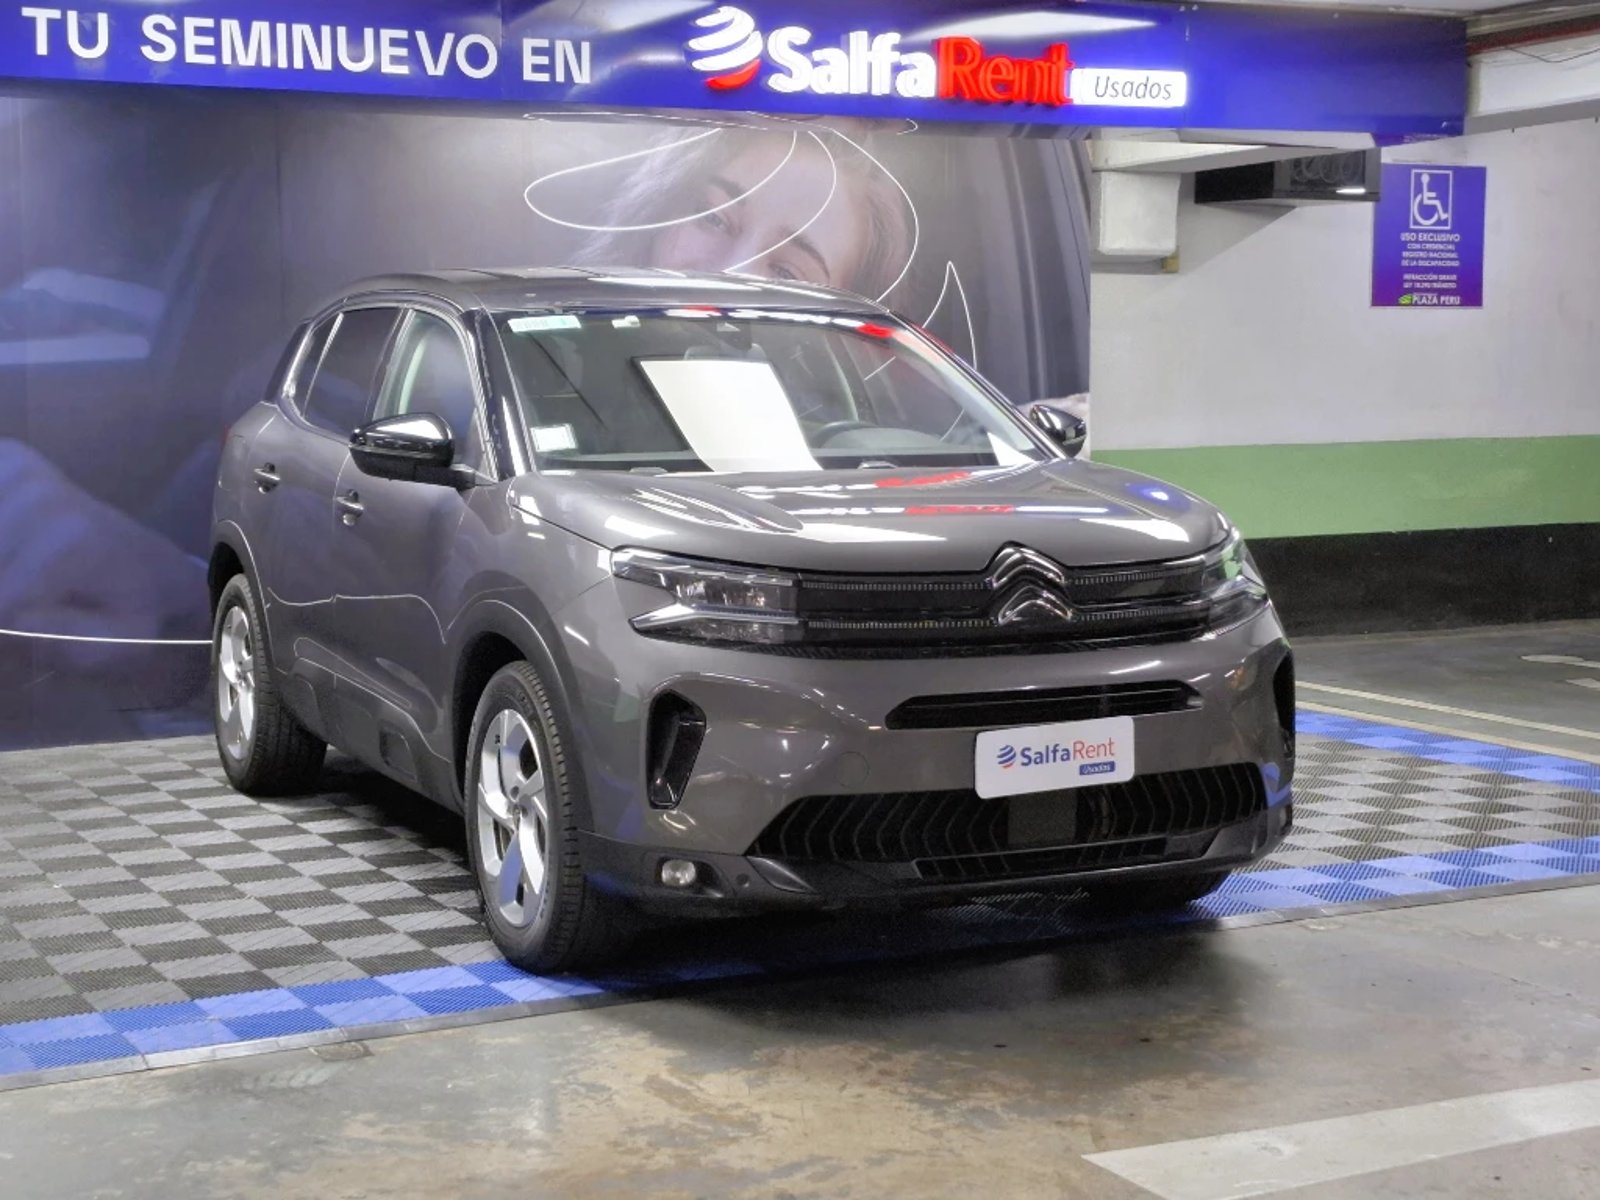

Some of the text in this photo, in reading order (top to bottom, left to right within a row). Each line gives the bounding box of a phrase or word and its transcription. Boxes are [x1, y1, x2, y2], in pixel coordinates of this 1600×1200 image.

[21, 7, 592, 84] TU SEMINUEVO EN
[766, 26, 1074, 107] SalfaRent
[1093, 74, 1173, 101] Usados
[1400, 232, 1461, 242] USO EXCLUSIVO
[1412, 294, 1438, 305] PLAZA
[1020, 737, 1115, 766] SalfaRent
